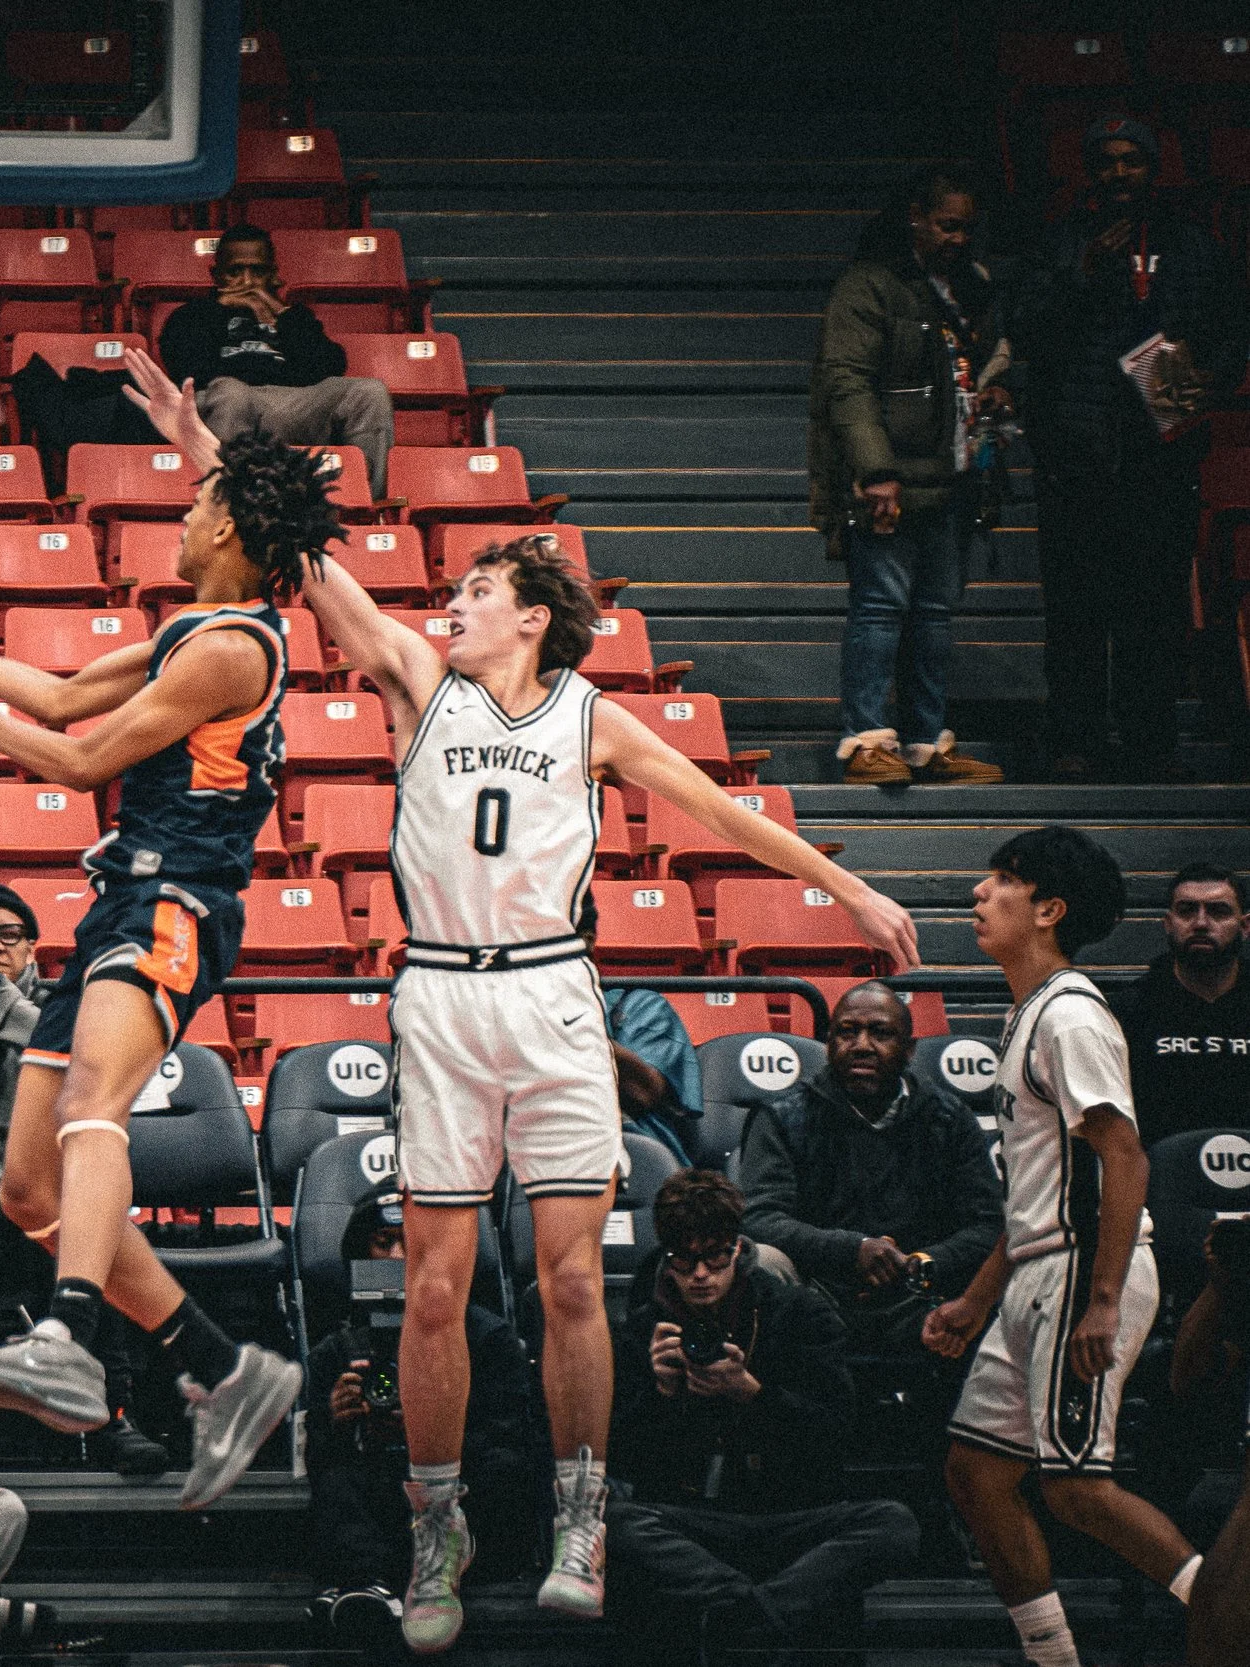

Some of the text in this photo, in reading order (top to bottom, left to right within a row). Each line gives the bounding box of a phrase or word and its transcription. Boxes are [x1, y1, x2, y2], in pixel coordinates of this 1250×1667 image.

[103, 342, 116, 356] 17
[46, 535, 60, 548] 16
[99, 618, 114, 632] 16
[335, 703, 349, 717] 17
[672, 703, 686, 718] 19
[443, 745, 557, 783] FENWICK
[44, 794, 59, 809] 15
[743, 796, 758, 811] 19
[474, 788, 510, 857] 0
[289, 890, 304, 905] 16
[641, 891, 656, 906] 18
[1155, 1037, 1200, 1054] SAC
[335, 1062, 382, 1080] UIC
[748, 1055, 794, 1074] UIC
[947, 1057, 995, 1076] UIC
[368, 1154, 396, 1172] UI
